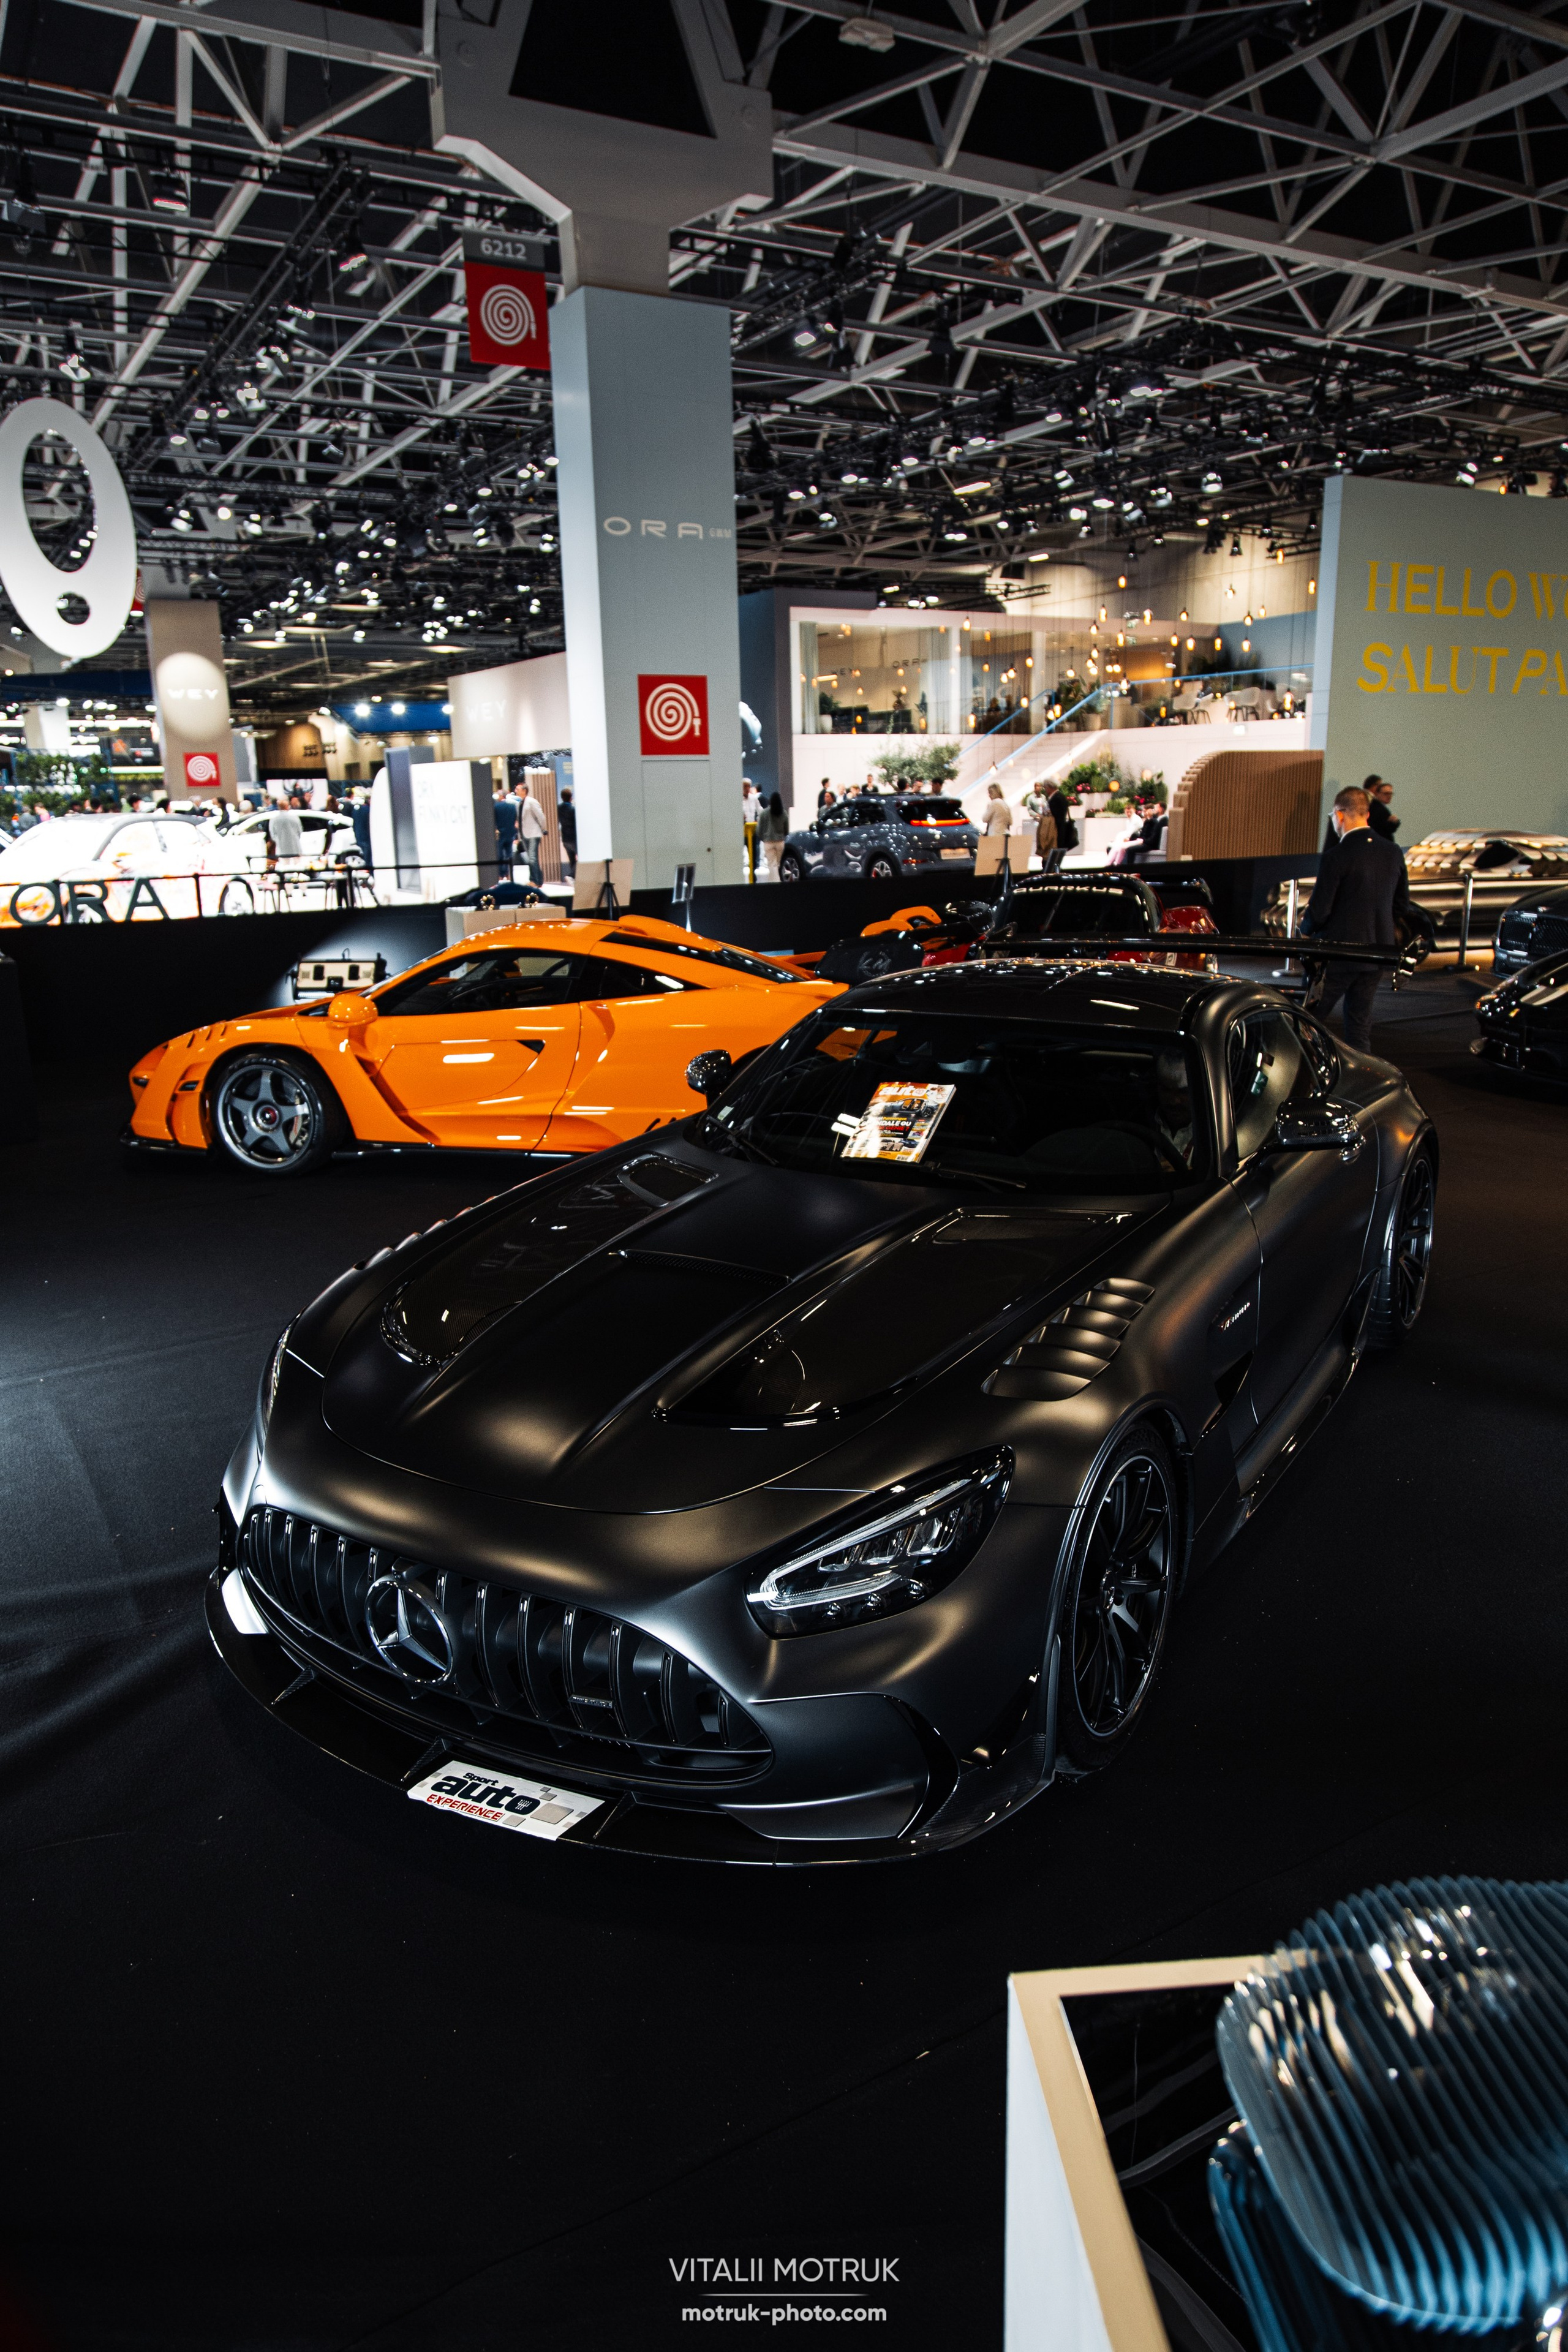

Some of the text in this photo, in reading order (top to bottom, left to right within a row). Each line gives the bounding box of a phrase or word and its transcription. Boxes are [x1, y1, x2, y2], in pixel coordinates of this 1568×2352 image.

[481, 238, 527, 260] 6212
[603, 516, 703, 540] ORA
[1365, 560, 1518, 619] HELLO
[1357, 641, 1509, 694] SALUT
[167, 688, 219, 700] WEY
[466, 699, 507, 722] WEY
[10, 878, 170, 925] ORA
[1012, 885, 1124, 895] QUARKUS
[879, 1085, 928, 1096] auto
[462, 1772, 499, 1786] Sport
[431, 1775, 541, 1815] auto
[426, 1793, 505, 1822] EXPERIENCE
